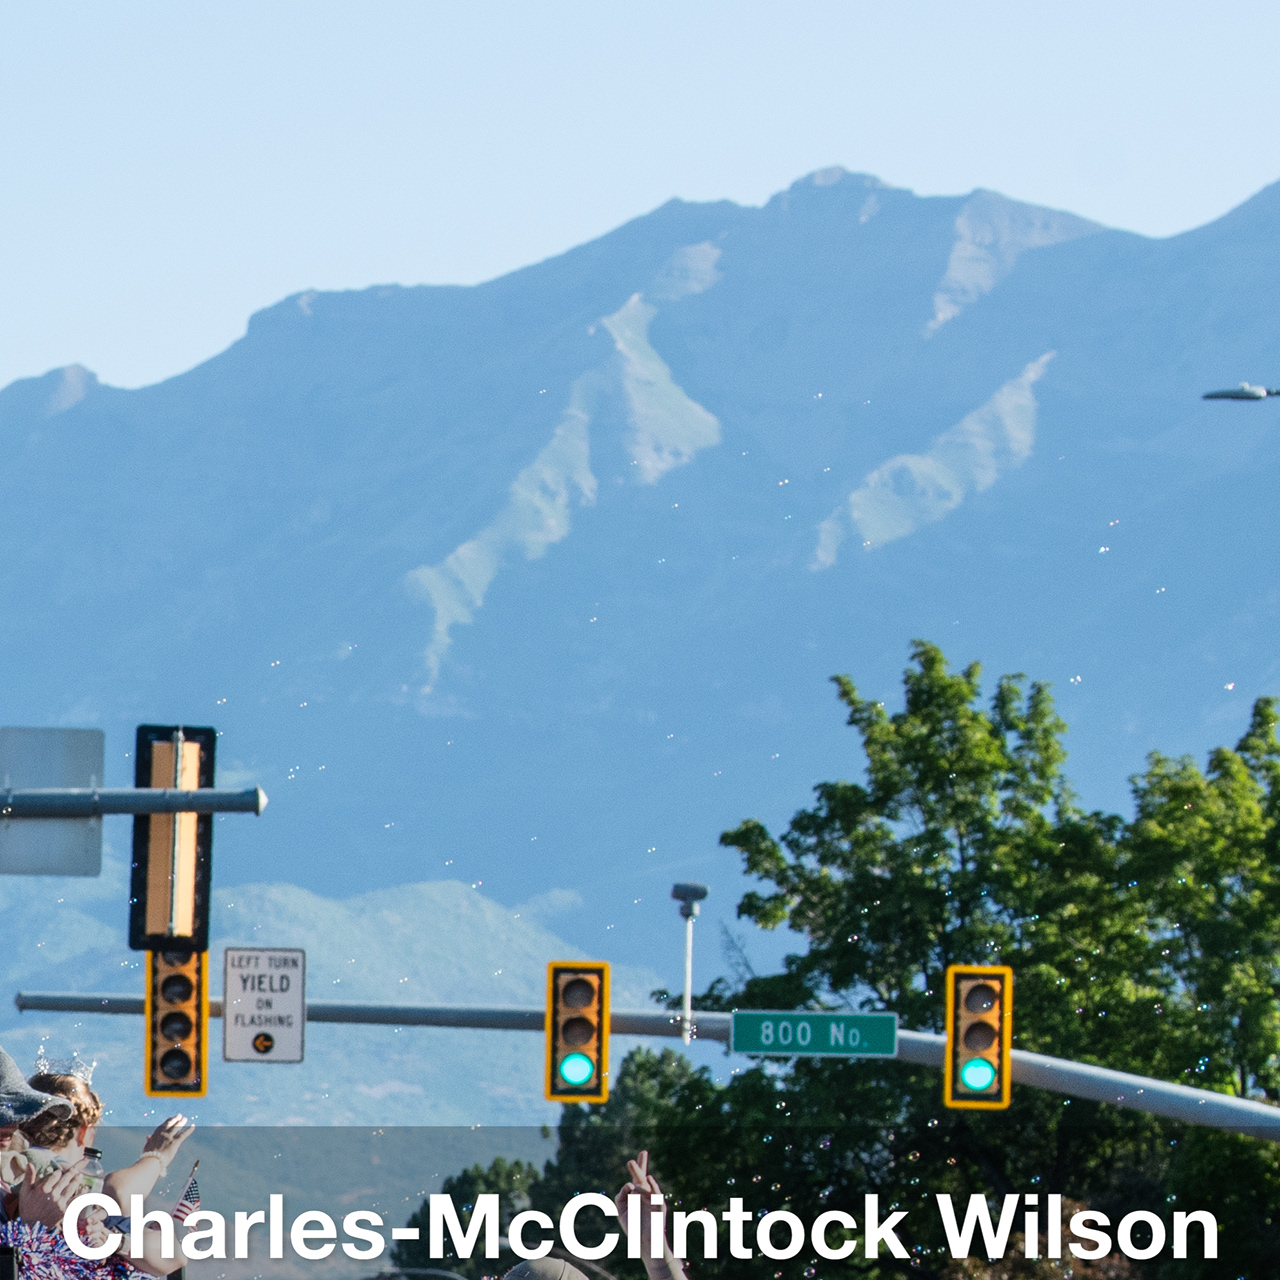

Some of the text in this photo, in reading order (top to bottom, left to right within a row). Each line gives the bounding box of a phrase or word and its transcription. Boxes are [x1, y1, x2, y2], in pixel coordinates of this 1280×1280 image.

[231, 955, 298, 970] LEFT TURN
[240, 974, 290, 993] YIELD
[255, 998, 273, 1010] ON
[234, 1013, 294, 1028] FLASHING
[761, 1020, 812, 1046] 800
